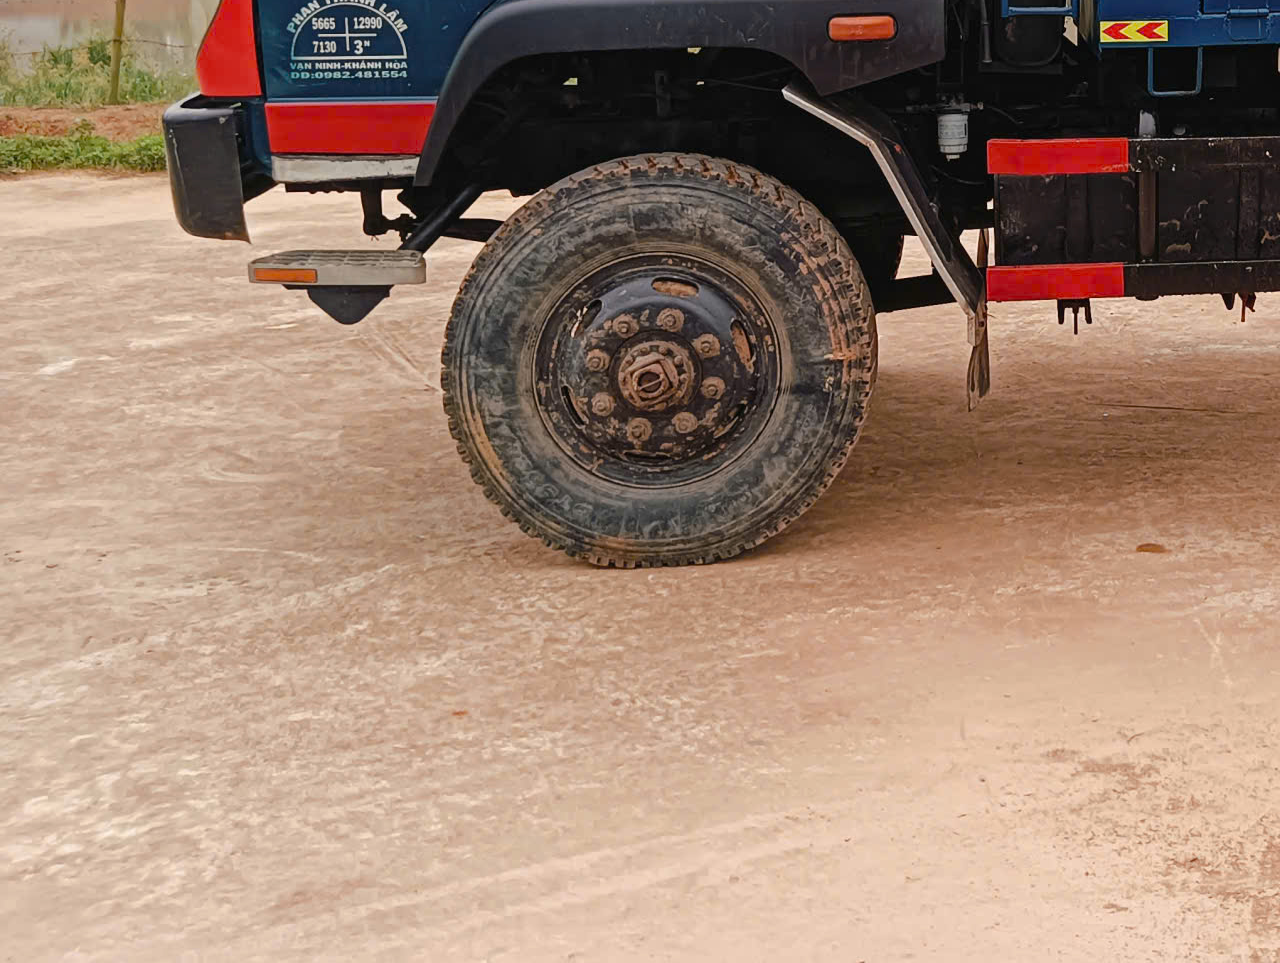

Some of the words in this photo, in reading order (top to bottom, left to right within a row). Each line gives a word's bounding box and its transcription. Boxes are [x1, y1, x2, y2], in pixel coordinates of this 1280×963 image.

[286, 0, 320, 33] PHAN
[378, 3, 408, 33] LÂM
[353, 16, 382, 29] 12990
[312, 17, 336, 30] 5665
[312, 41, 337, 53] 7130
